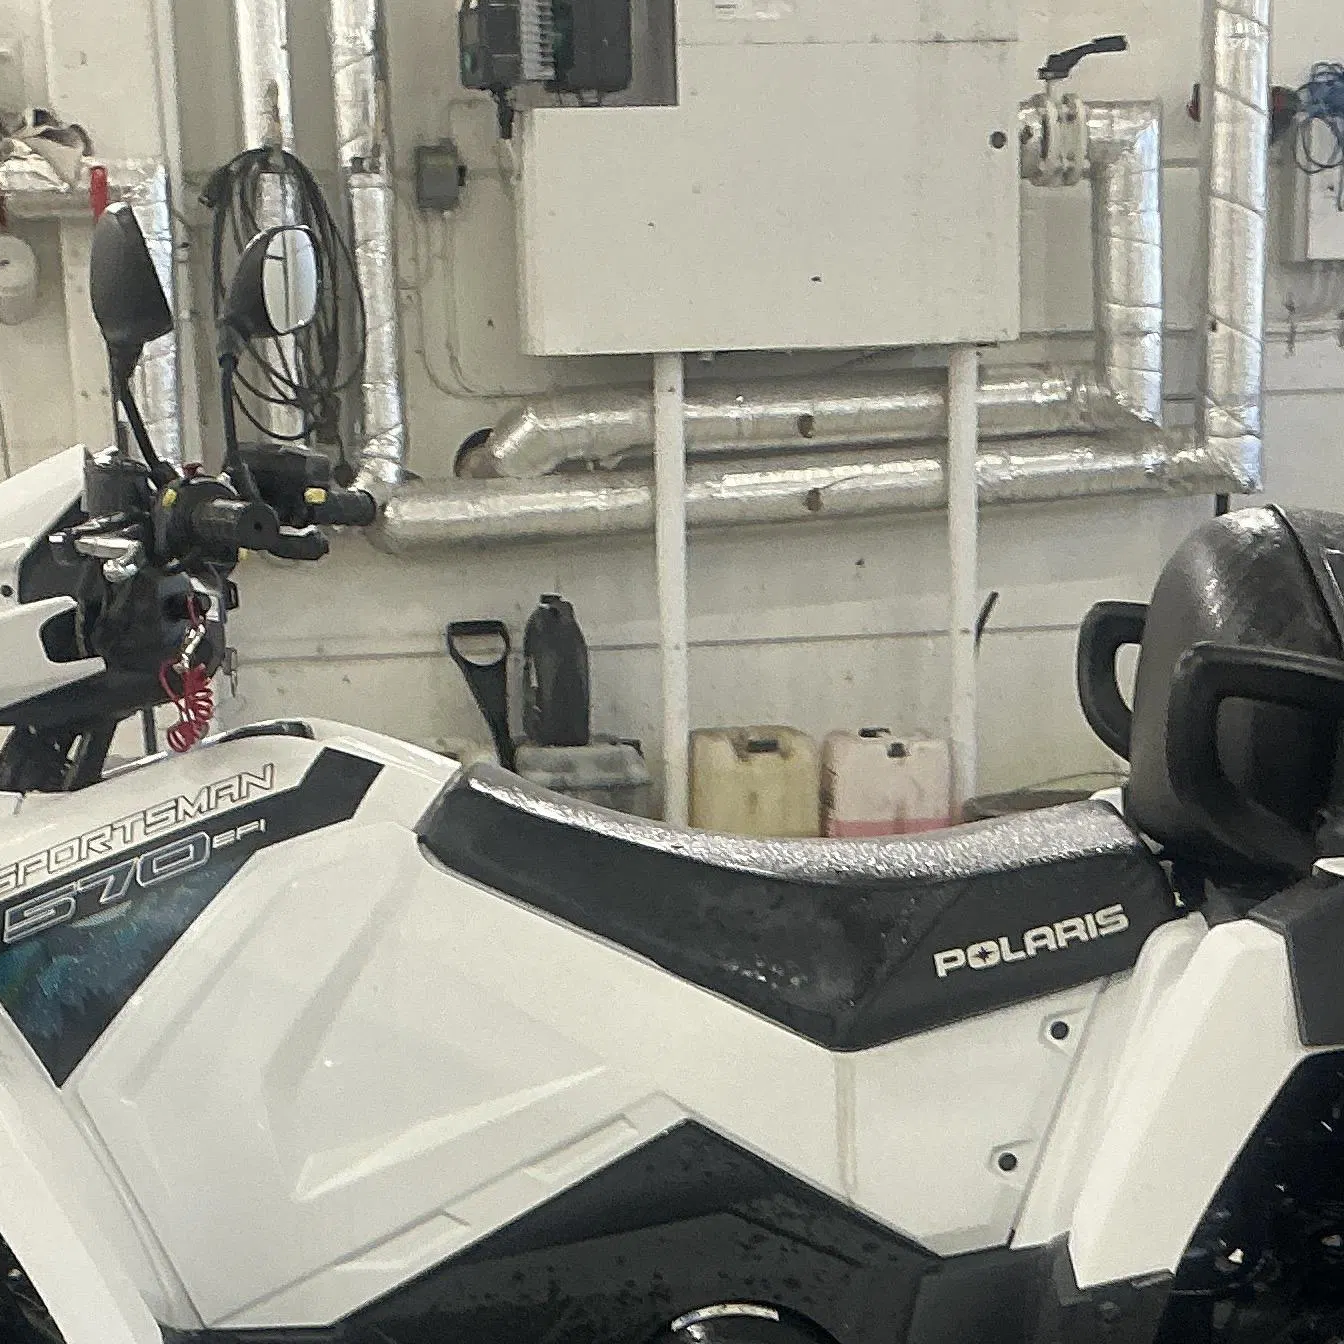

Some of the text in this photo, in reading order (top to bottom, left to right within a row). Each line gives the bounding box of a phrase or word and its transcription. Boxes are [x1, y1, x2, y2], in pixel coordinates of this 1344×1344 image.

[3, 818, 267, 943] 570 EFI
[933, 903, 1130, 978] POLARIS
